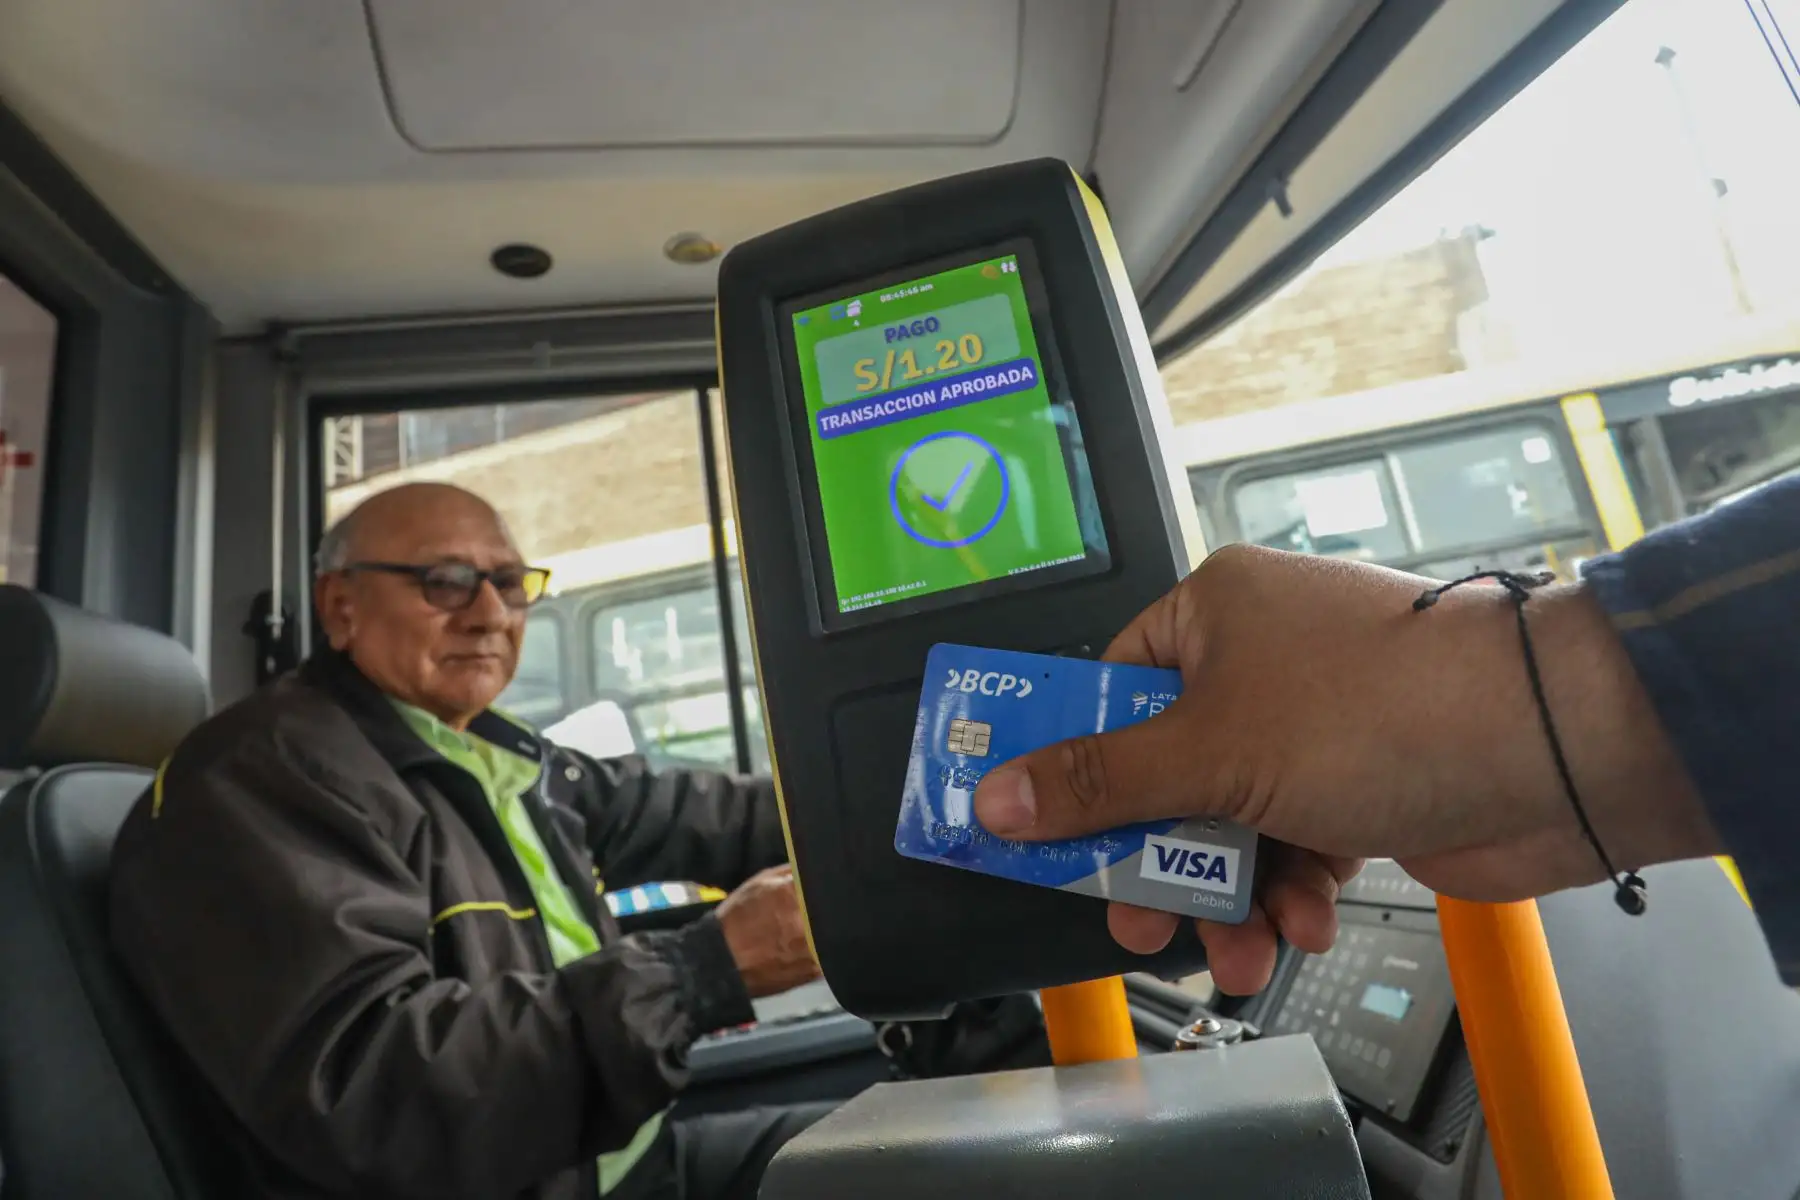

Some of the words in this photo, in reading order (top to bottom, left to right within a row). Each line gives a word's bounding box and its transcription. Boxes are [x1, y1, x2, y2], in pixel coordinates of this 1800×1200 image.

[884, 316, 941, 344] PAGO
[853, 333, 984, 392] S/1.20
[820, 389, 937, 431] TRANSACCION
[940, 366, 1033, 402] APROBADA
[959, 670, 1017, 697] BCP
[1151, 691, 1177, 701] LATA
[1151, 843, 1228, 884] VISA
